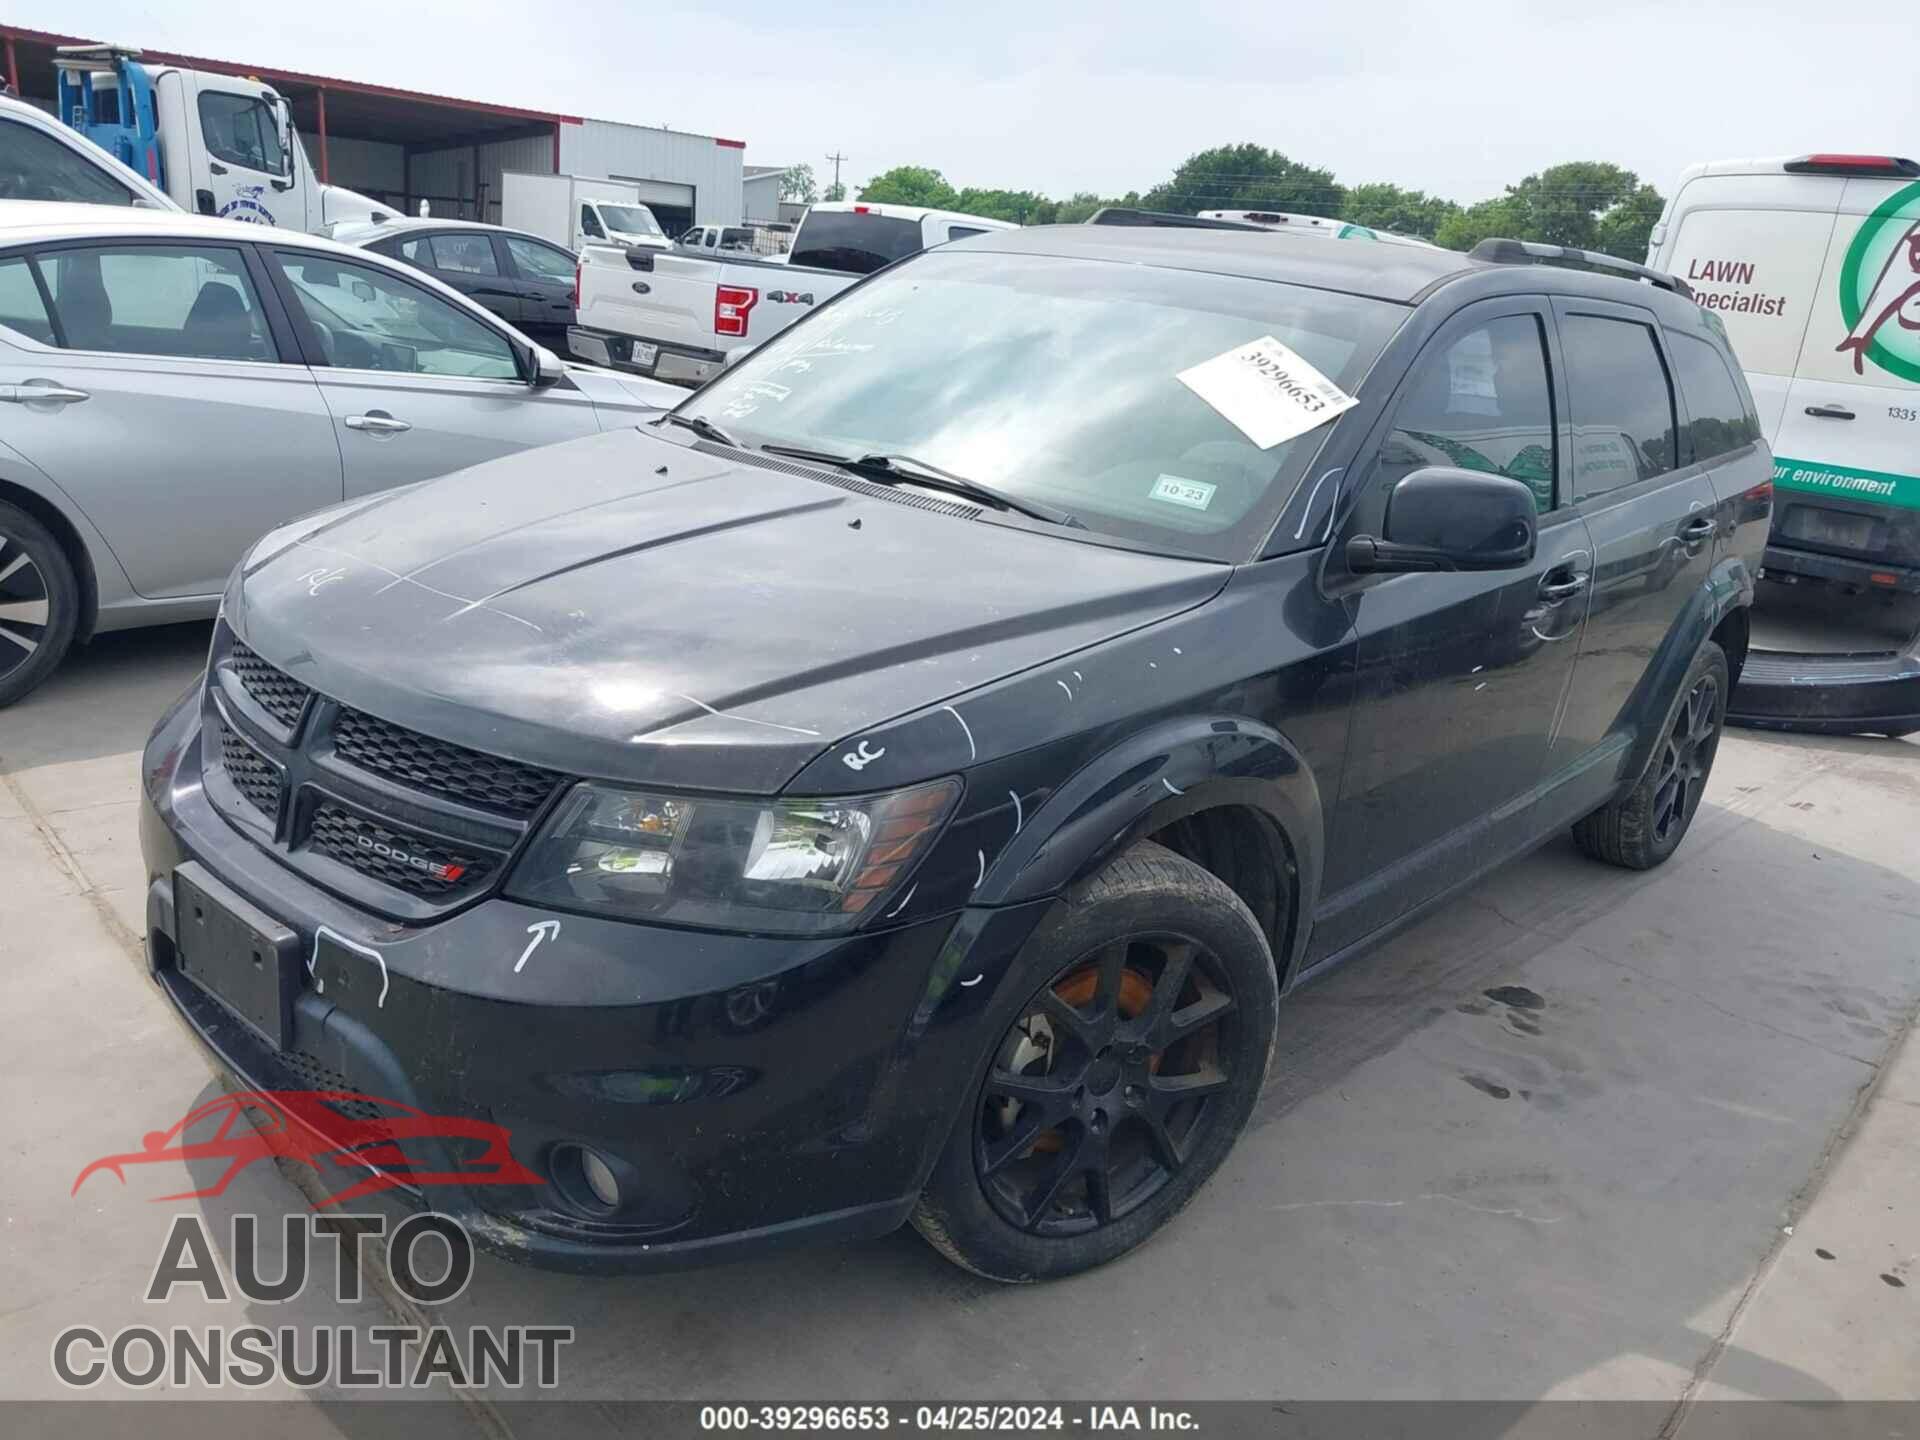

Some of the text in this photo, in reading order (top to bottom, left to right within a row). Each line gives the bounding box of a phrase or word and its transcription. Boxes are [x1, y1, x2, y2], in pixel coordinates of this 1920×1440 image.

[1688, 258, 1755, 285] LAWN
[1241, 351, 1326, 412] 39296653
[1887, 406, 1917, 421] 1335
[1792, 468, 1896, 495] environment
[358, 835, 448, 875] DODGE
